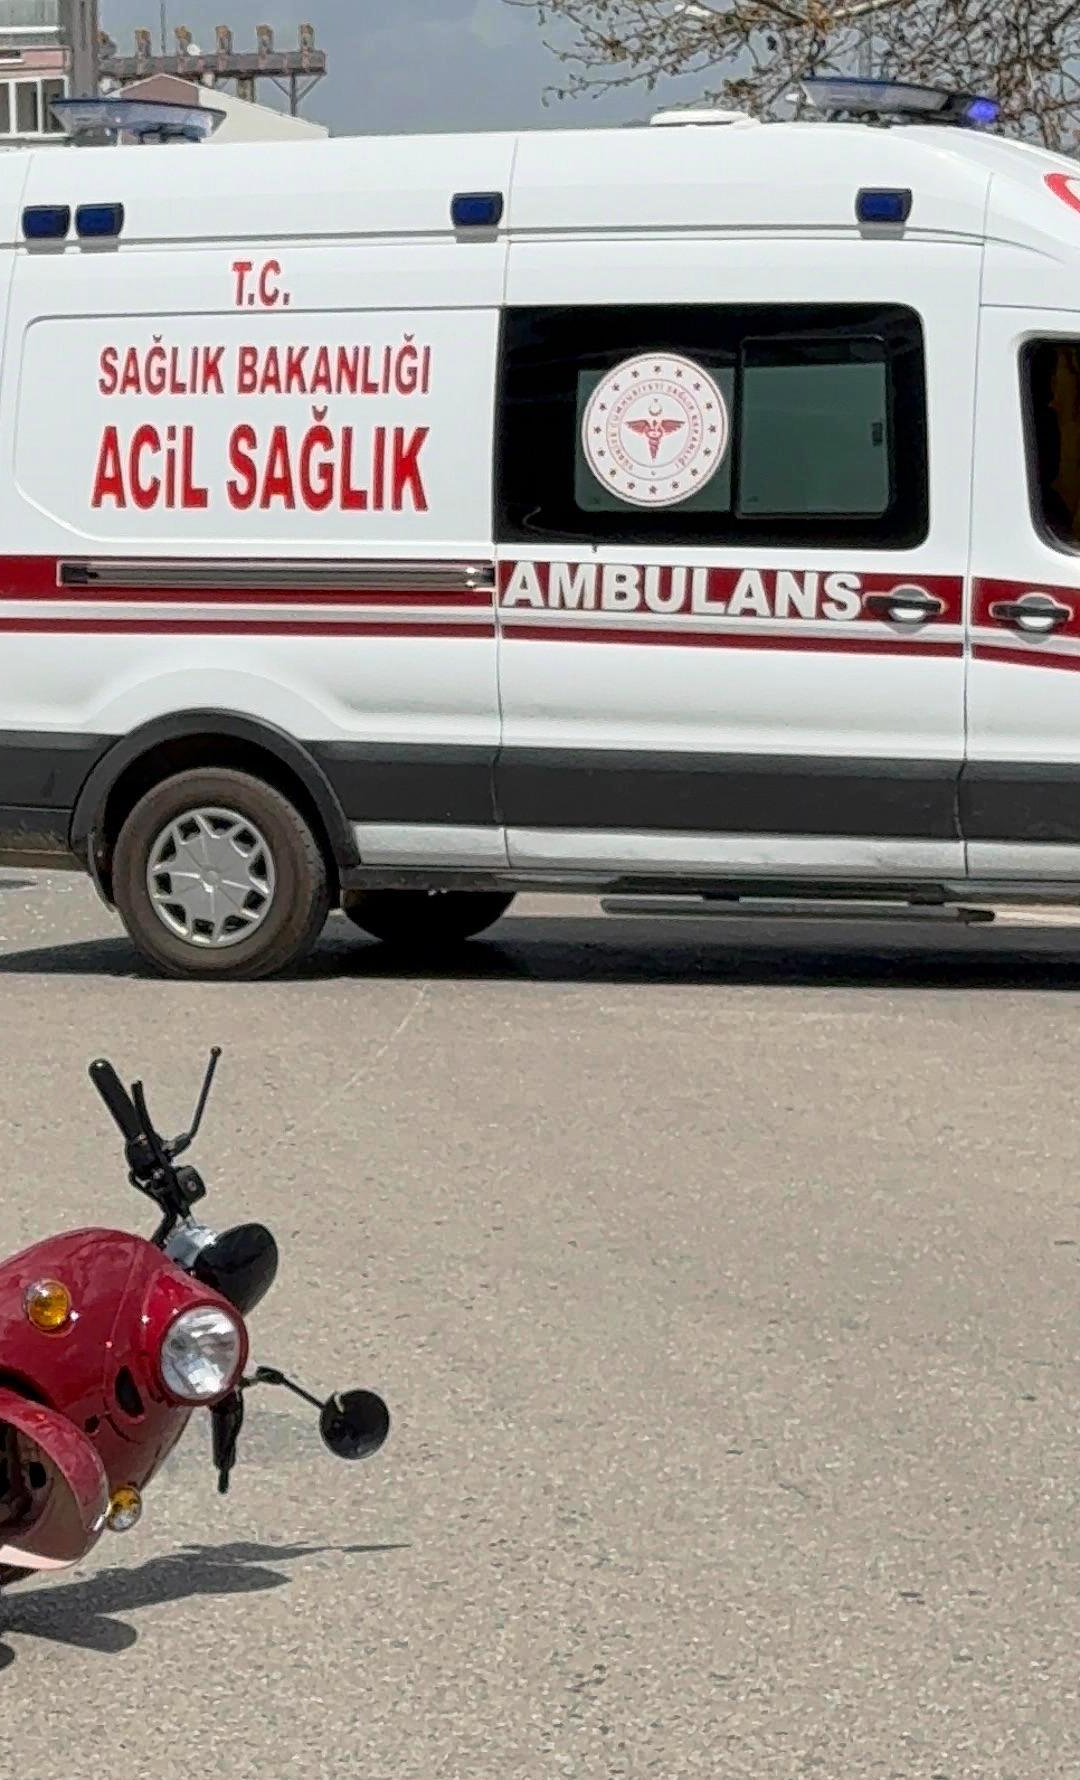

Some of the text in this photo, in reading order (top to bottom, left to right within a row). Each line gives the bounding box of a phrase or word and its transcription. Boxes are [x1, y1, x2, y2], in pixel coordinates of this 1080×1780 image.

[232, 259, 291, 306] T.C.
[98, 333, 431, 395] SAĞLIK BAKANLIĞI
[226, 404, 430, 511] SAĞLIK
[502, 560, 863, 622] AMBULANS
